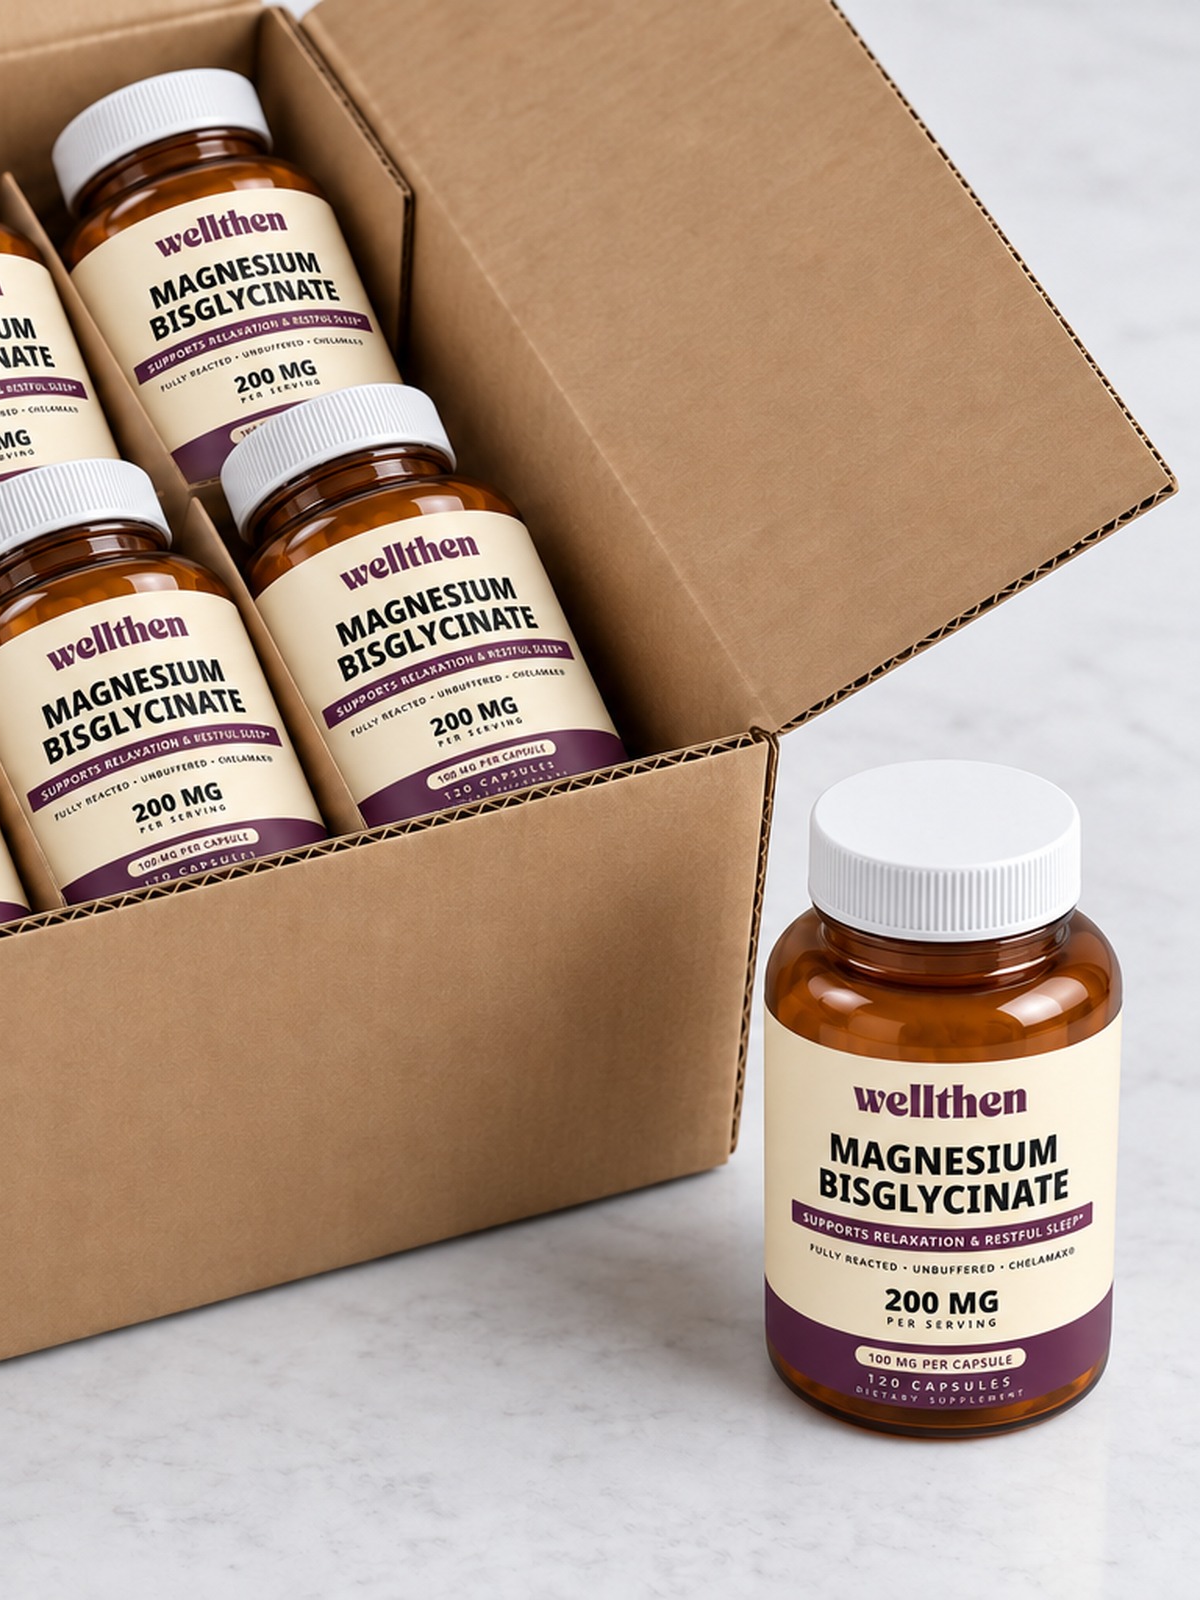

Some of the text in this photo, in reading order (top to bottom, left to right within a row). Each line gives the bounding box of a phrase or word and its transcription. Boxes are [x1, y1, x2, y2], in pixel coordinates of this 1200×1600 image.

[154, 209, 288, 257] wellthen
[149, 252, 321, 309] MAGNESIUM
[149, 279, 340, 342] BISGLYCINATE
[233, 359, 317, 394] 200 MG
[240, 391, 263, 404] PER
[339, 535, 480, 591] wellthen
[335, 577, 517, 647] MAGNESIUM
[46, 615, 189, 671] wellthen
[337, 605, 539, 682] BISGLYCINATE
[41, 659, 225, 730] MAGNESIUM
[338, 680, 397, 717] SUPPORTS
[42, 688, 246, 765] BISGLYCINATE
[429, 696, 518, 737] 200 MG
[437, 733, 461, 747] PER
[42, 764, 101, 801] SUPPORTS
[131, 782, 223, 823] 200 MG
[139, 820, 163, 834] PER
[853, 1083, 1027, 1119] wellthen
[830, 1132, 1057, 1176] MAGNESIUM
[819, 1168, 1069, 1215] BISGLYCINATE
[803, 1211, 869, 1241] SUPPORTS
[874, 1231, 965, 1248] RELAXATION
[970, 1237, 979, 1247] &
[985, 1229, 1043, 1246] RESTFUL
[809, 1242, 842, 1262] FULLY
[845, 1255, 898, 1272] REACTED
[913, 1263, 995, 1275] UNBUFFERED
[885, 1288, 999, 1314] 200 MG
[887, 1316, 997, 1329] PER SERVING
[868, 1353, 1013, 1370] 100 MG PER CAPSULE
[868, 1374, 1011, 1392] 120 CAPSULES
